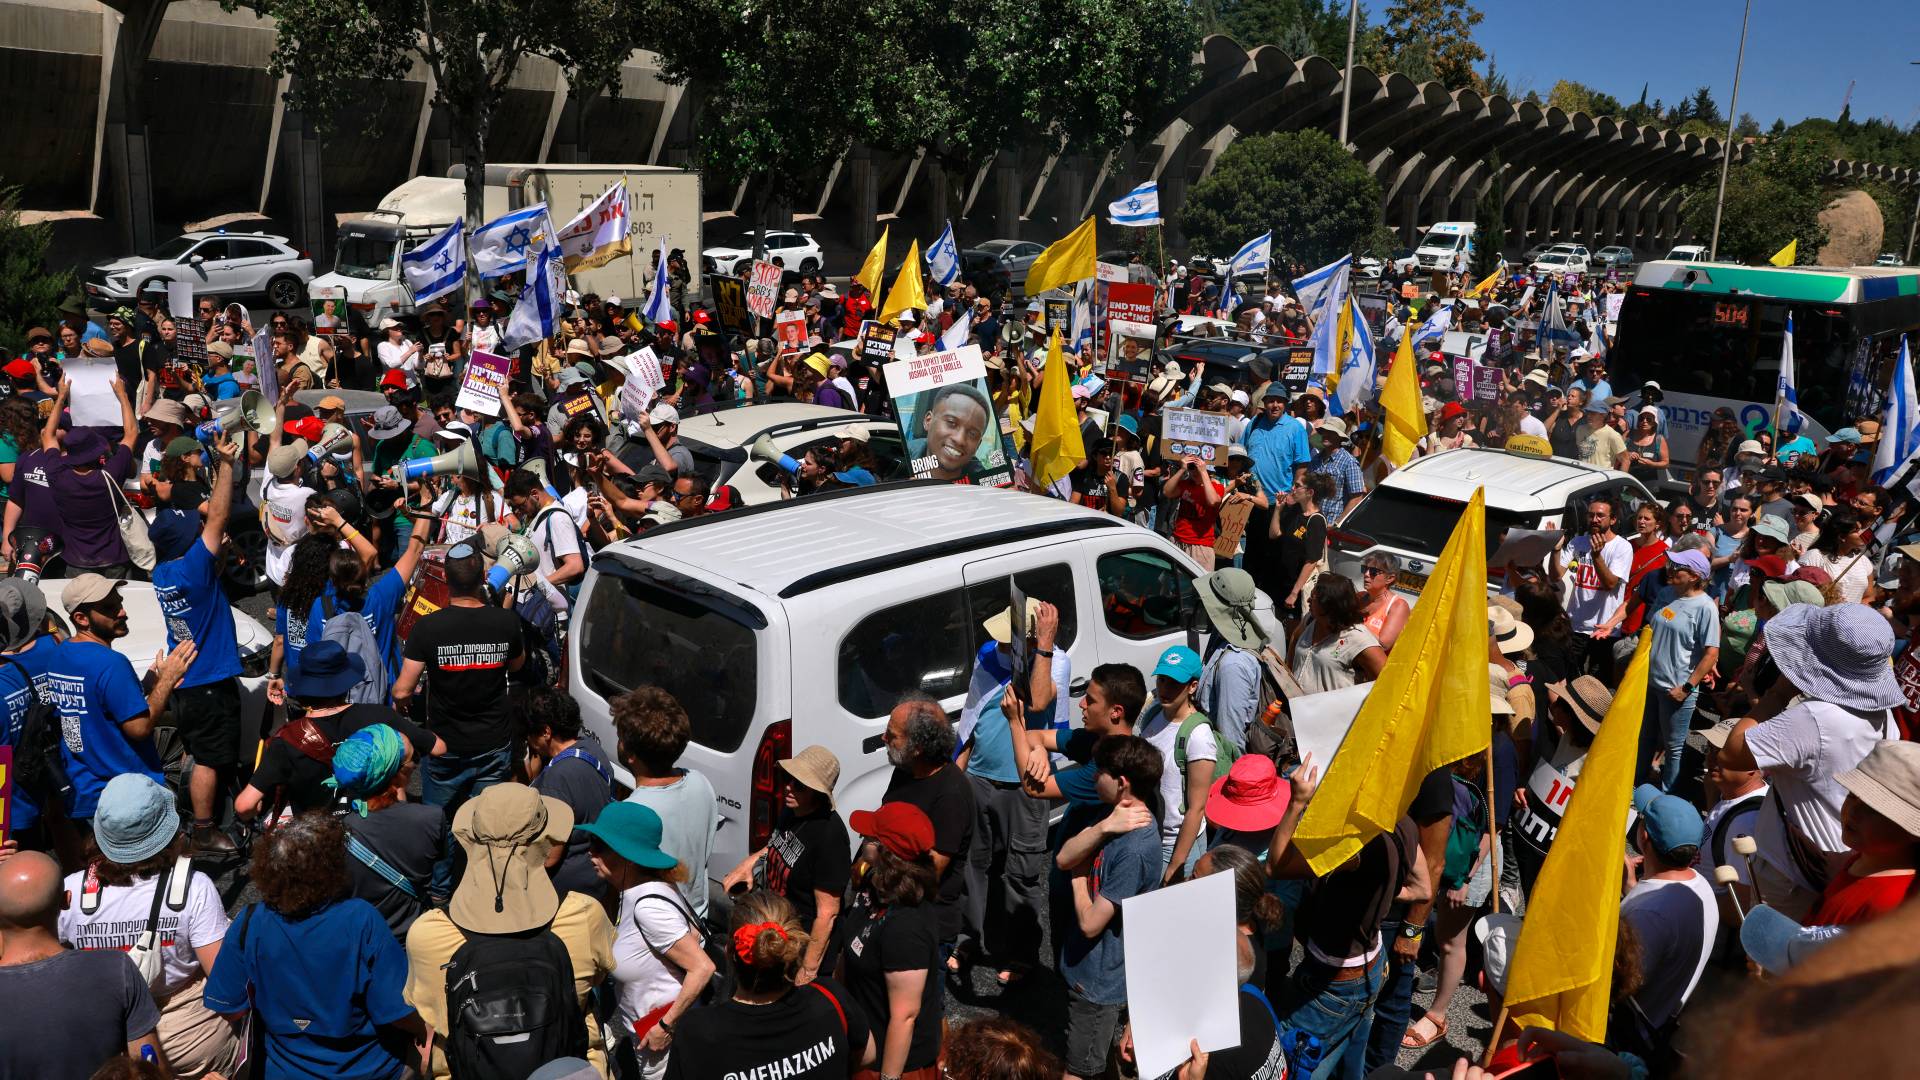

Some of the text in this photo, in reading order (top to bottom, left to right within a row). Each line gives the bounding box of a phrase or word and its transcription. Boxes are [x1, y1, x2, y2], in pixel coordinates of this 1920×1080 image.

[752, 262, 780, 288] STOP
[1109, 302, 1151, 313] END THIS
[909, 370, 928, 380] JOSHUA
[944, 361, 963, 372] MOLLEL
[911, 454, 939, 474] BRING
[438, 644, 463, 656] להחזרת
[464, 643, 496, 654] המשפחות
[438, 654, 474, 667] והנעדרים
[77, 922, 109, 936] להחזרת
[111, 919, 149, 934] משפחות
[77, 935, 127, 950] והנעדרים
